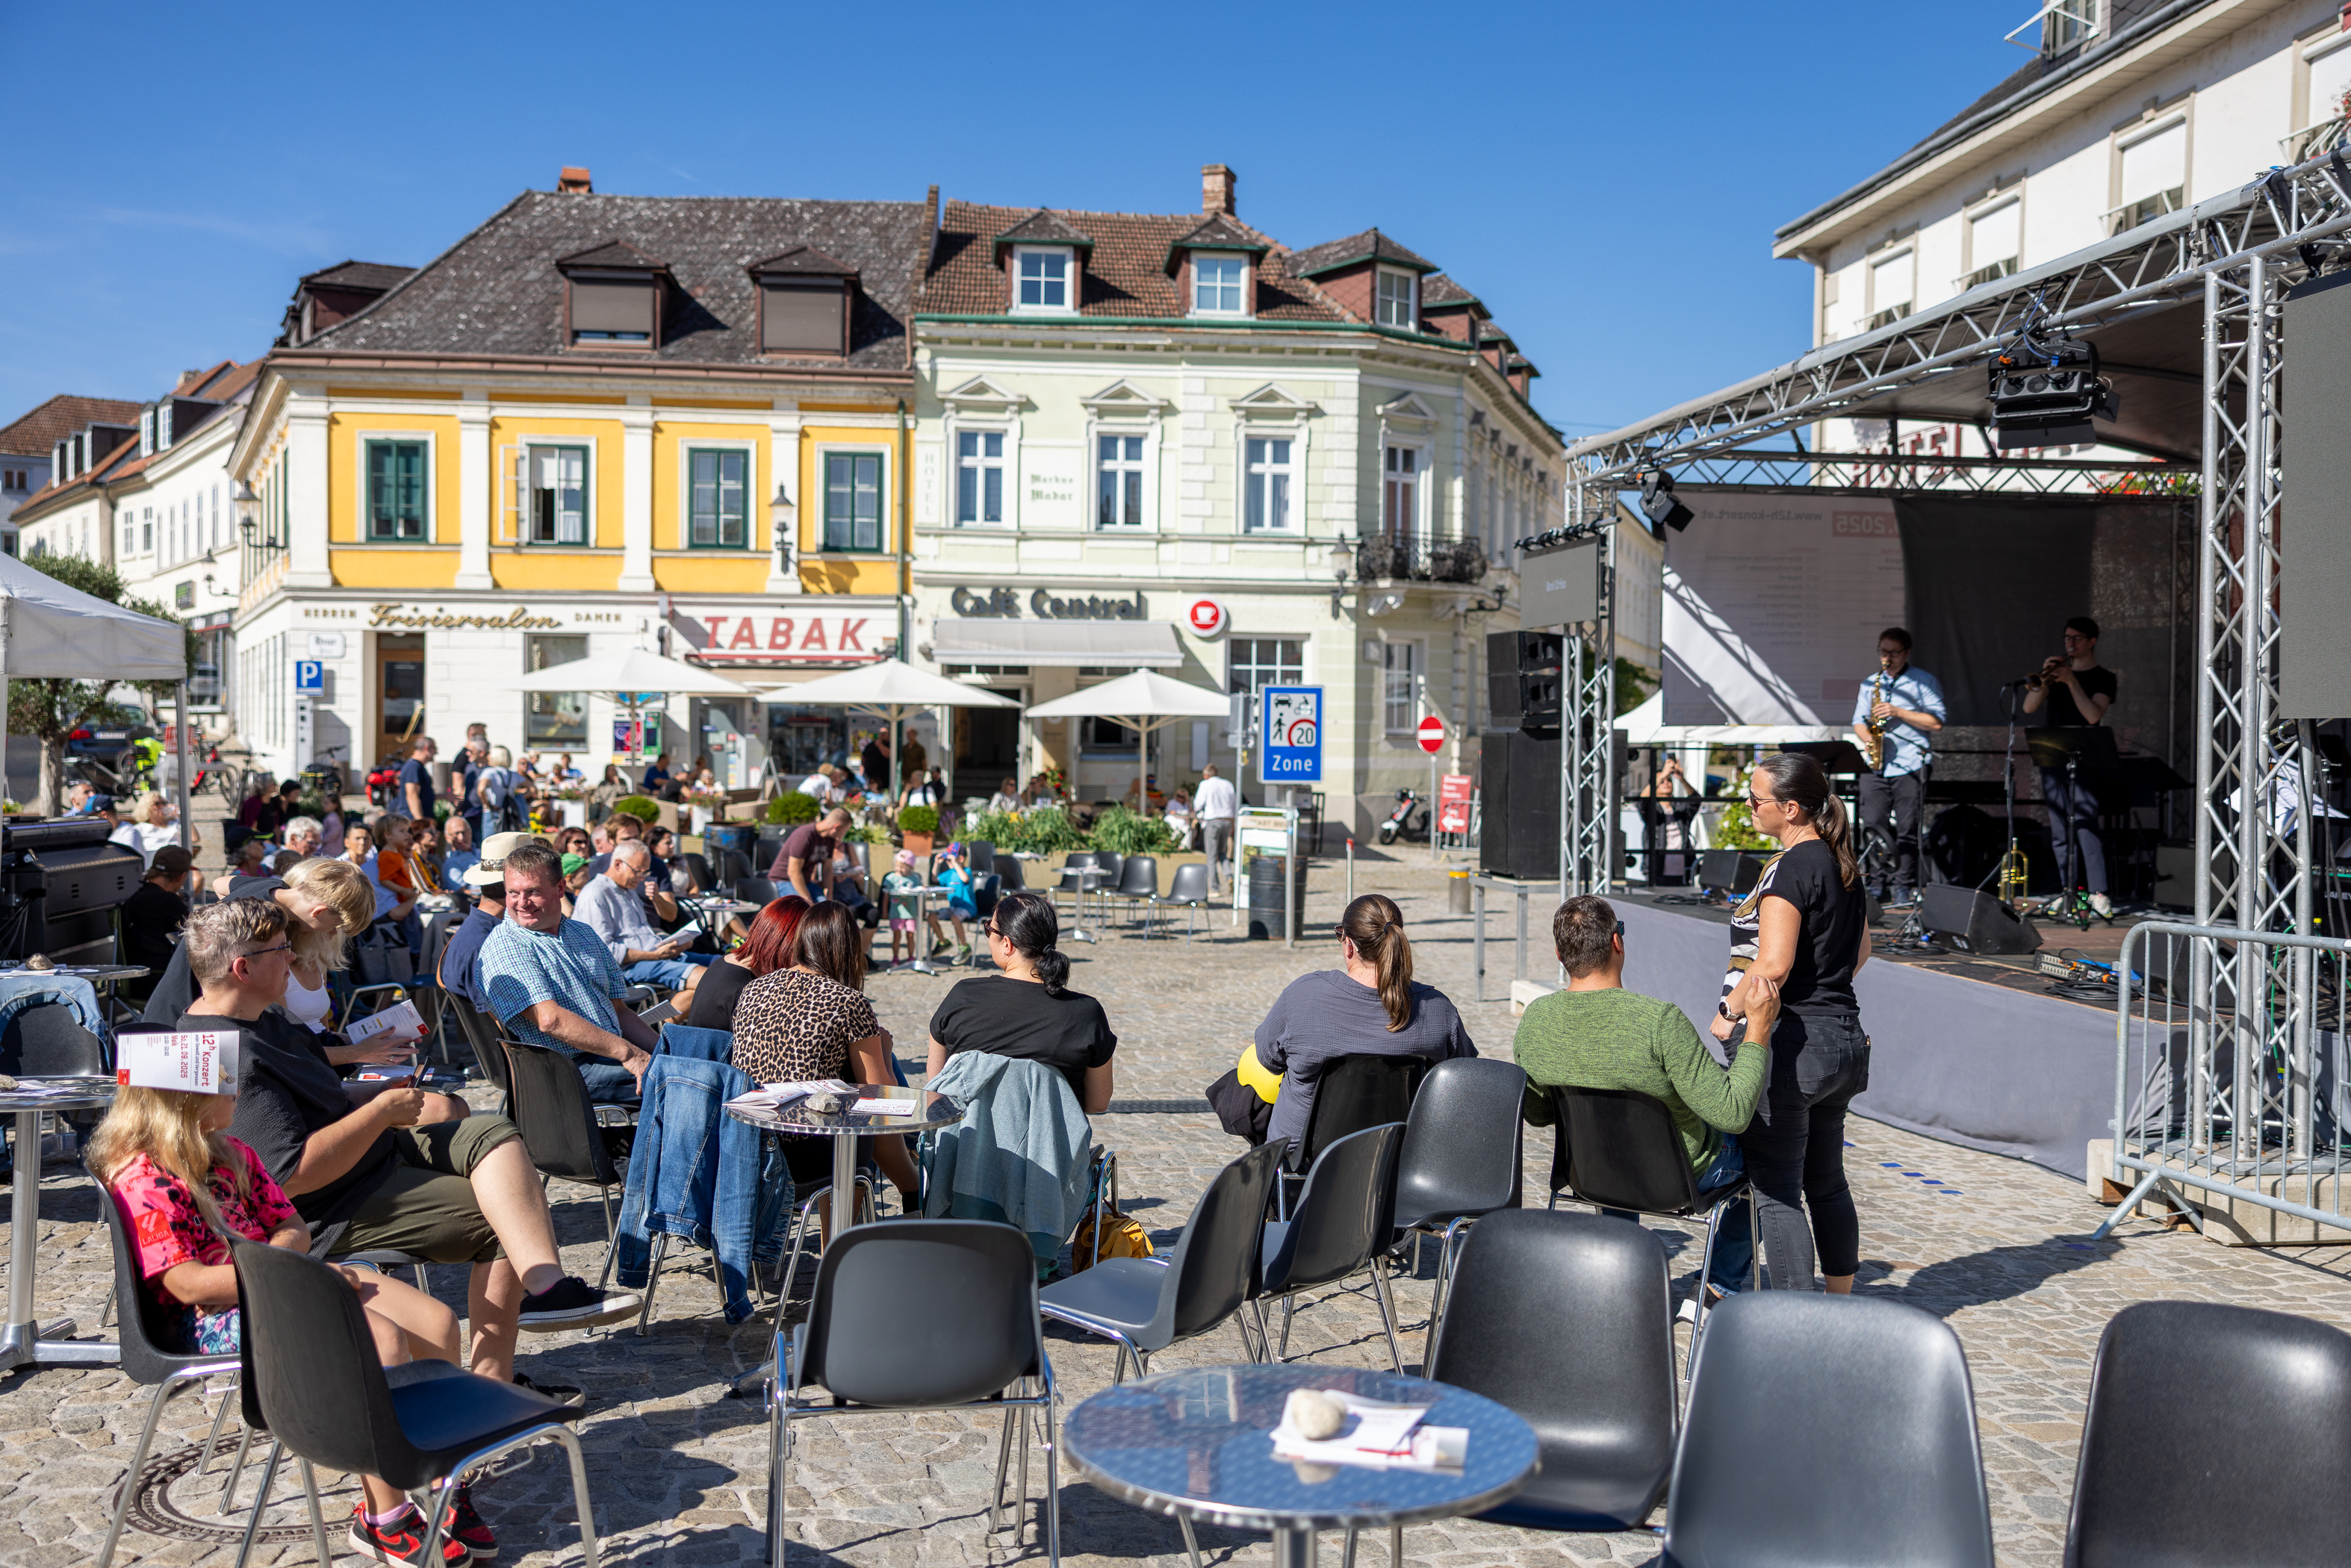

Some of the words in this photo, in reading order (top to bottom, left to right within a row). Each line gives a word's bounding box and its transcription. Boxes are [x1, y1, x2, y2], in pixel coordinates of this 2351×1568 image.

[925, 453, 934, 516] HOTEL
[304, 609, 357, 618] HERREN
[369, 602, 563, 629] Frisiersalon
[574, 612, 623, 622] DAMEN
[1031, 587, 1141, 616] Central
[705, 616, 869, 651] TABAK
[301, 662, 318, 687] P
[1296, 727, 1314, 745] 20
[1273, 755, 1314, 772] Zone
[202, 1051, 211, 1086] Konzert
